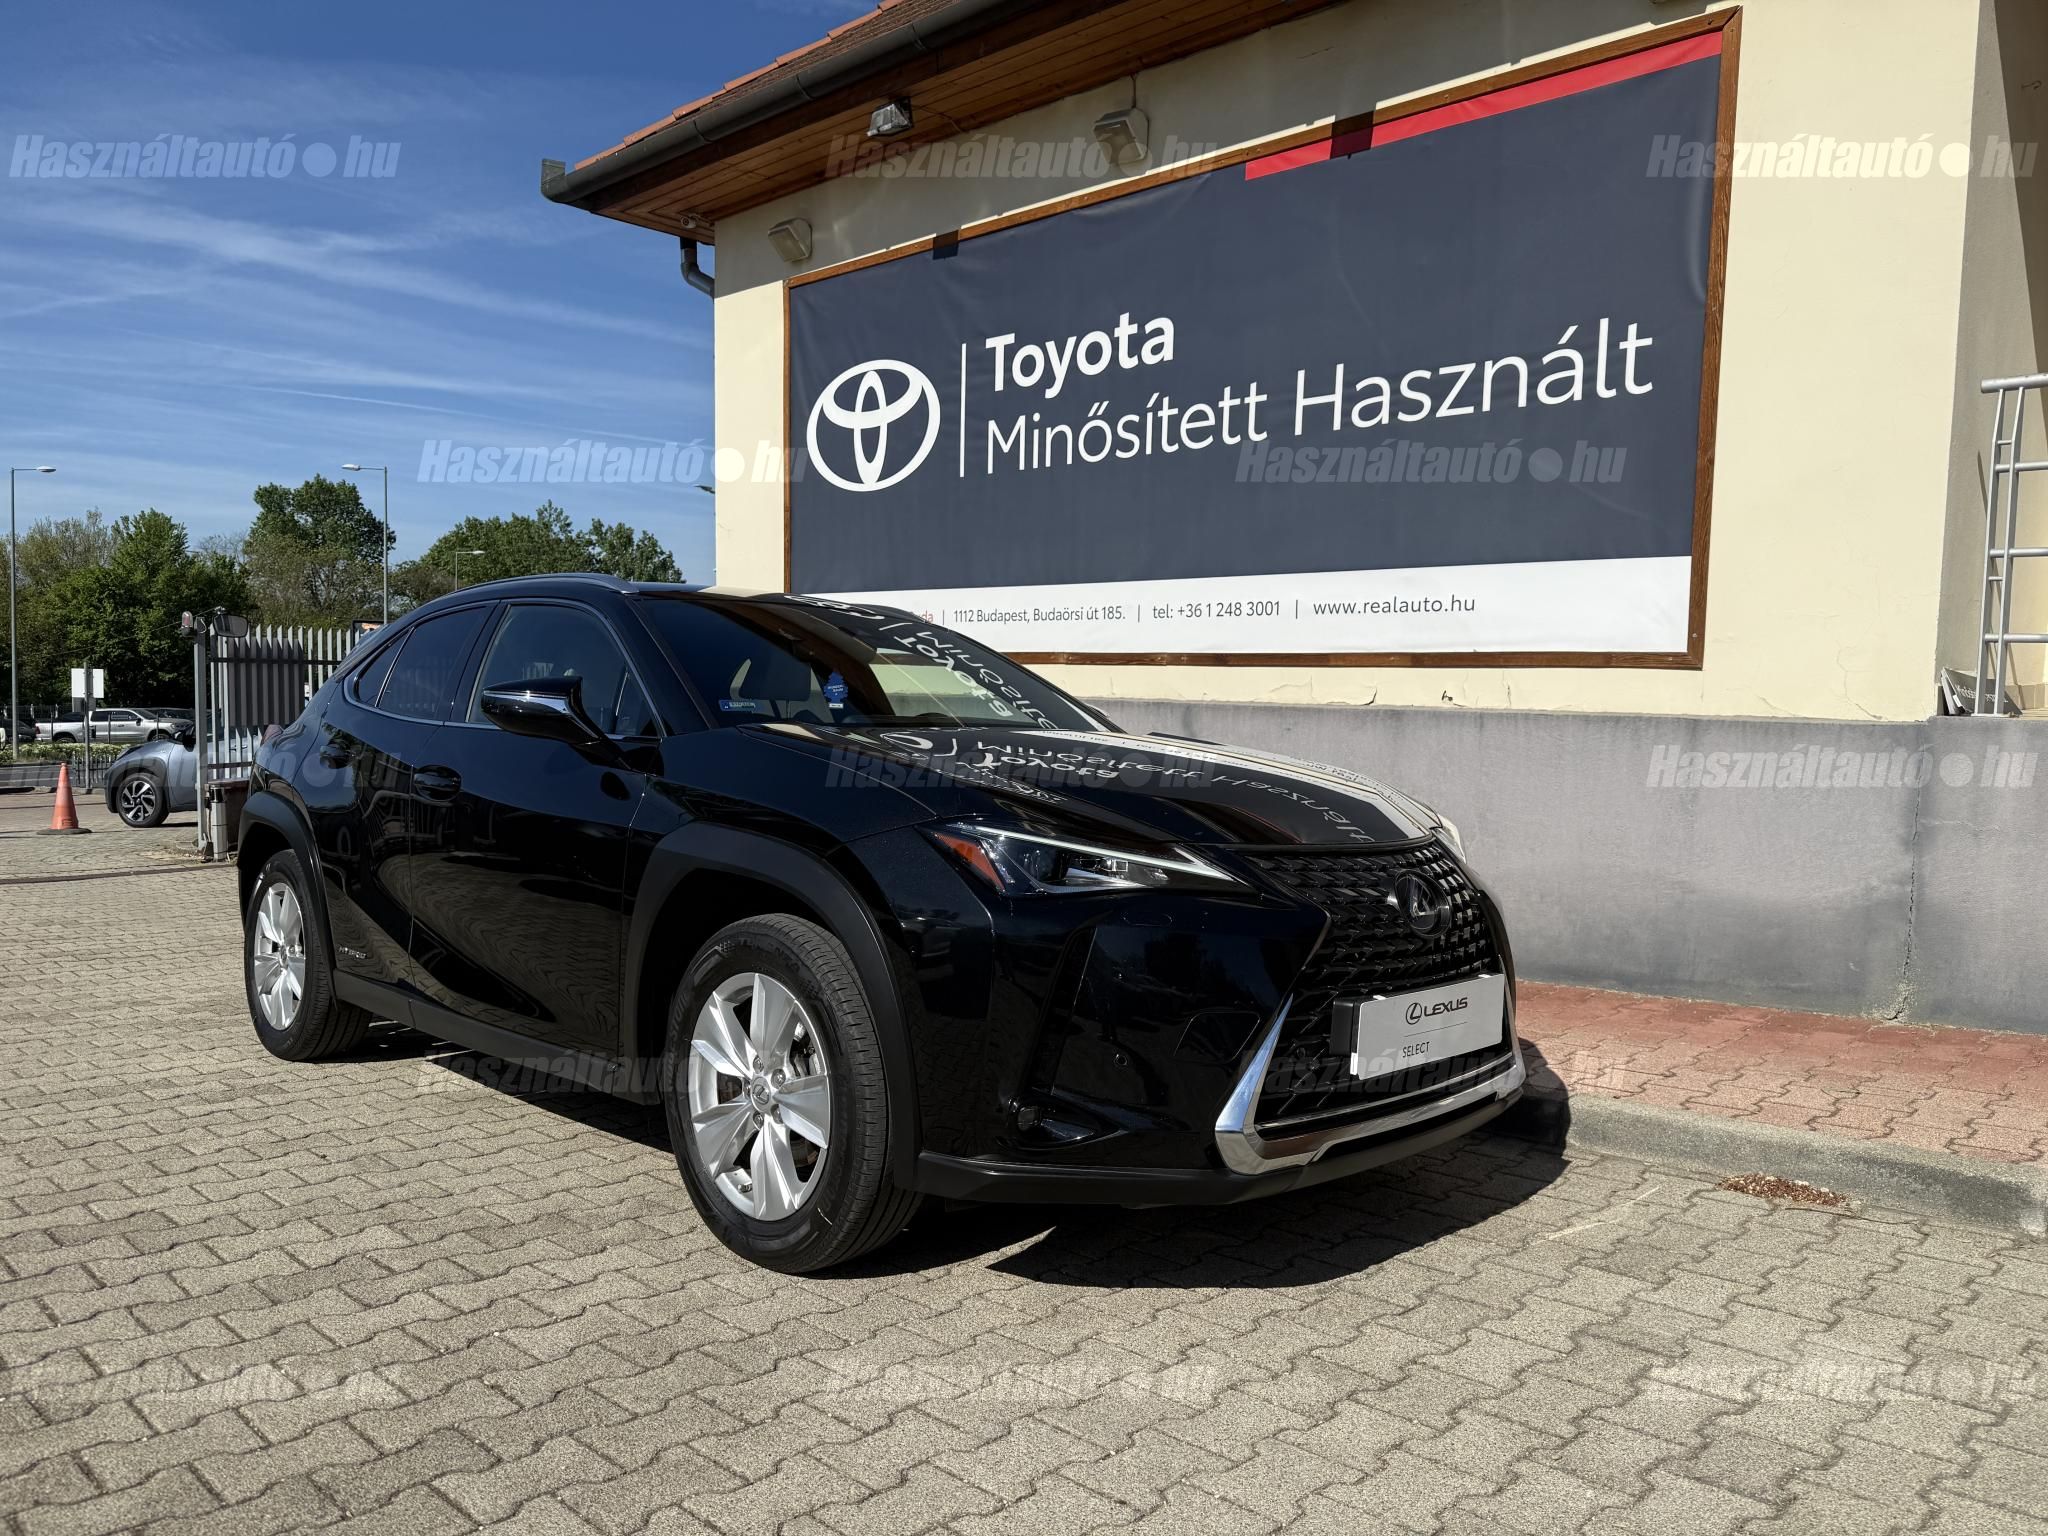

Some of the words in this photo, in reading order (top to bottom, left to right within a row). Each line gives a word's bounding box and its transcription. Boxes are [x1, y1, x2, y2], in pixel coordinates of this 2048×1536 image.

[985, 312, 1175, 399] Toyota
[987, 382, 1268, 474] Minősített
[1294, 318, 1653, 436] Használt
[953, 609, 975, 623] 1112
[976, 608, 1031, 626] Budapest,
[1033, 606, 1084, 623] Budaörsi
[1086, 606, 1099, 622] út
[1101, 606, 1126, 621] 185.
[1152, 604, 1174, 620] tel:
[1177, 602, 1202, 618] +36
[1206, 602, 1212, 618] 1
[1216, 601, 1242, 617] 248
[1246, 601, 1281, 617] 3001
[1313, 594, 1476, 615] www.realauto.hu
[1423, 996, 1468, 1017] LEXUS
[1402, 1041, 1430, 1059] SELECT
